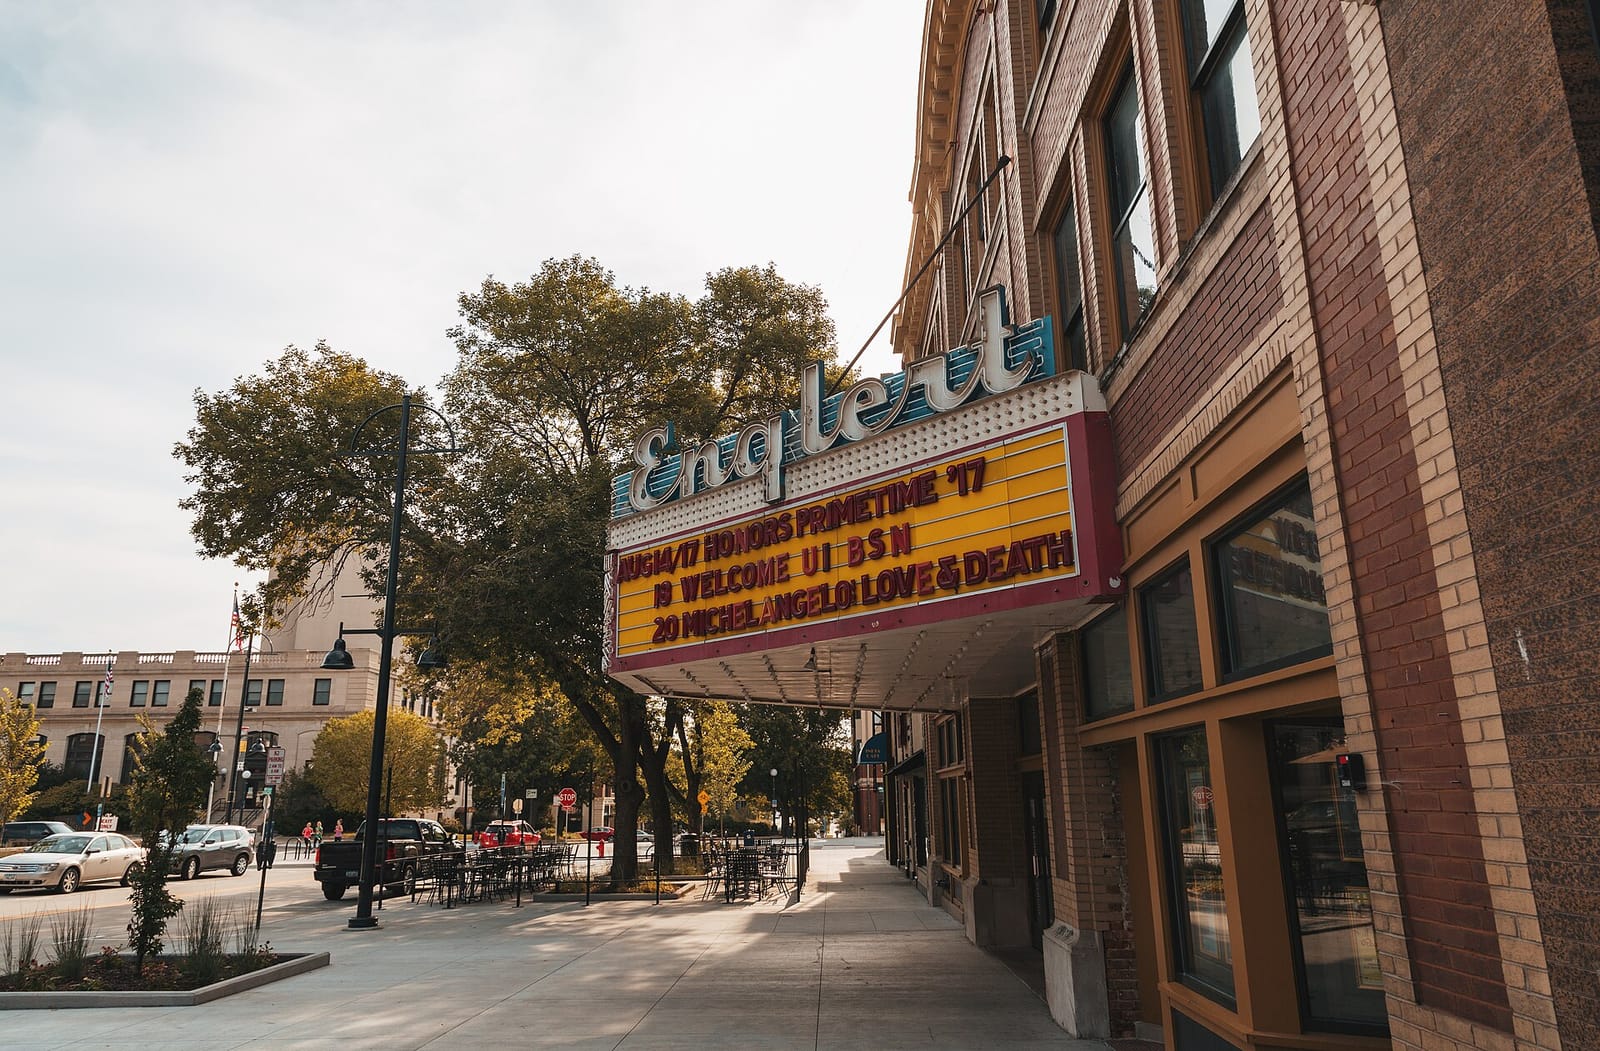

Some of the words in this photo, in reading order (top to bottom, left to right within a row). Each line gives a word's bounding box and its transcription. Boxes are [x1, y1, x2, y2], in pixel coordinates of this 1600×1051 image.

[629, 285, 1040, 512] Englert
[704, 513, 793, 562] HONORS
[795, 469, 938, 538] PRIMETIME
[946, 456, 985, 496] '17
[651, 614, 680, 644] 20
[861, 560, 935, 606] LOVE
[936, 554, 961, 593] &
[963, 529, 1075, 587] DEATH
[680, 551, 791, 603] WELCOME
[801, 542, 831, 577] UI
